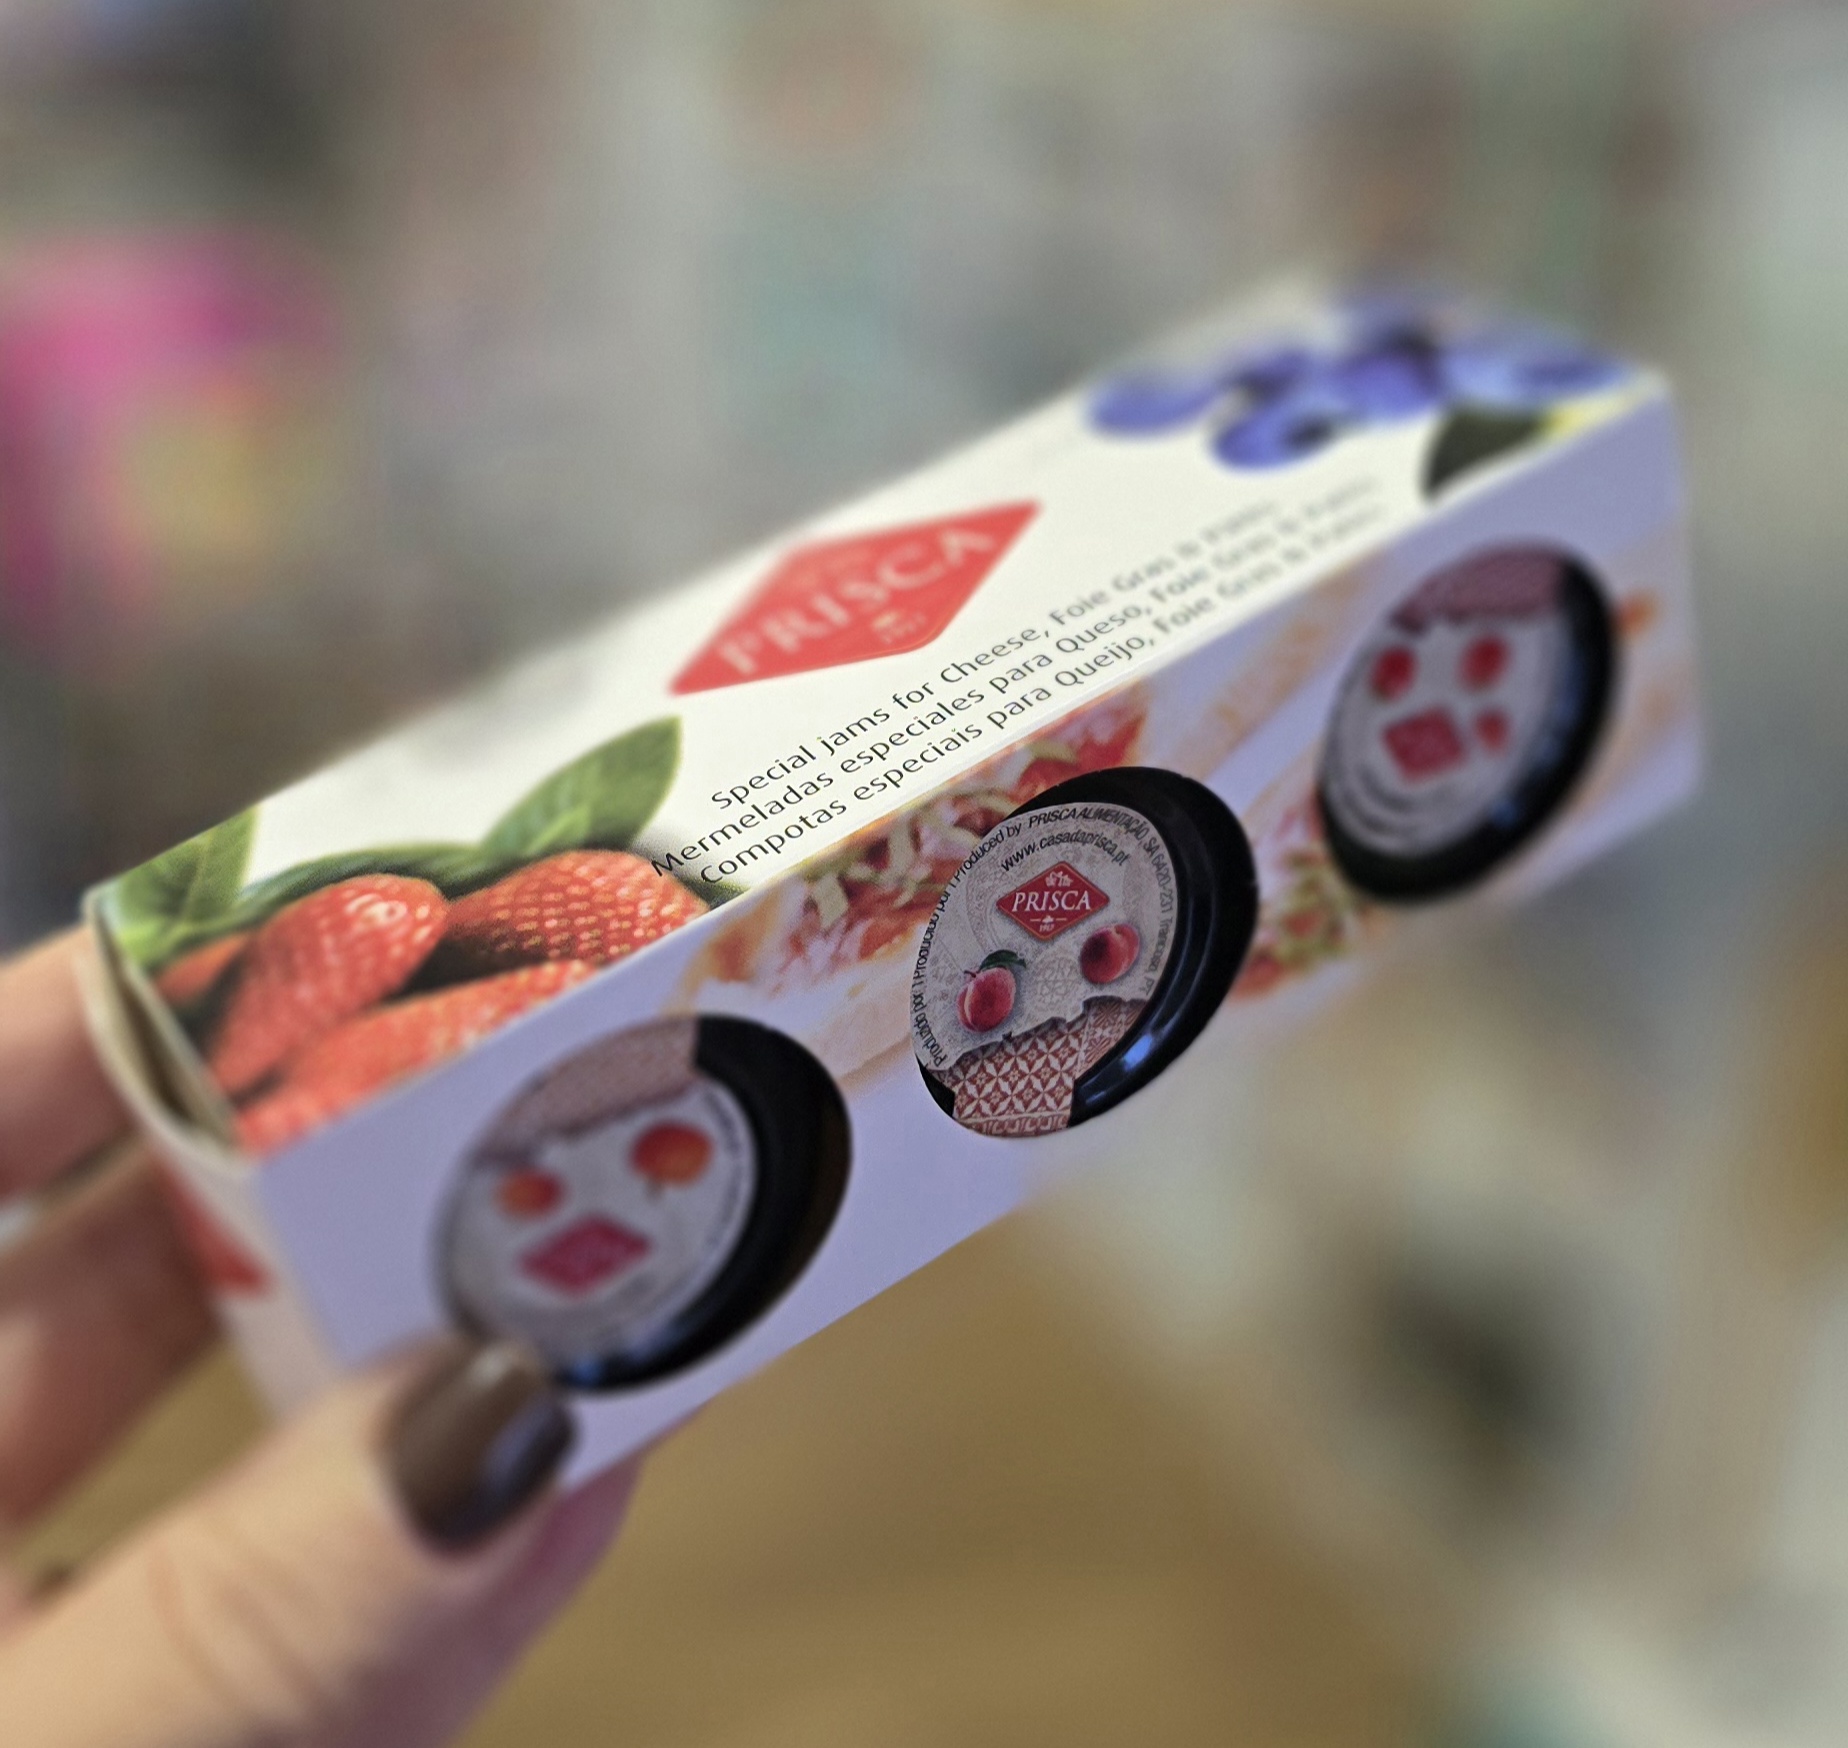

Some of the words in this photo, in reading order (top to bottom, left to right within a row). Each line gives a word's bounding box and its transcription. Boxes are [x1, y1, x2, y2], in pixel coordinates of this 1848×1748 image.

[711, 745, 817, 810] Special
[817, 708, 890, 757] jams
[892, 682, 935, 710] for
[940, 628, 1051, 684] Cheese,
[1048, 588, 1109, 627] Foie
[651, 771, 834, 878] Mermeladas
[840, 688, 985, 774] especiales
[989, 653, 1053, 695] para
[1055, 604, 1152, 654] Queso,
[700, 799, 847, 884] Compotas
[853, 723, 983, 801] especiais
[987, 687, 1052, 730] para
[1054, 633, 1155, 687] Queijo,
[1005, 823, 1022, 837] by
[1028, 807, 1076, 829] PRISCA
[954, 829, 1005, 882] Produced
[1001, 829, 1131, 871] www.casadaprisca.pt
[1143, 836, 1161, 859] SA
[1011, 890, 1091, 912] PRISCA
[1151, 854, 1174, 913] 6420-231
[914, 1012, 947, 1067] Produzido
